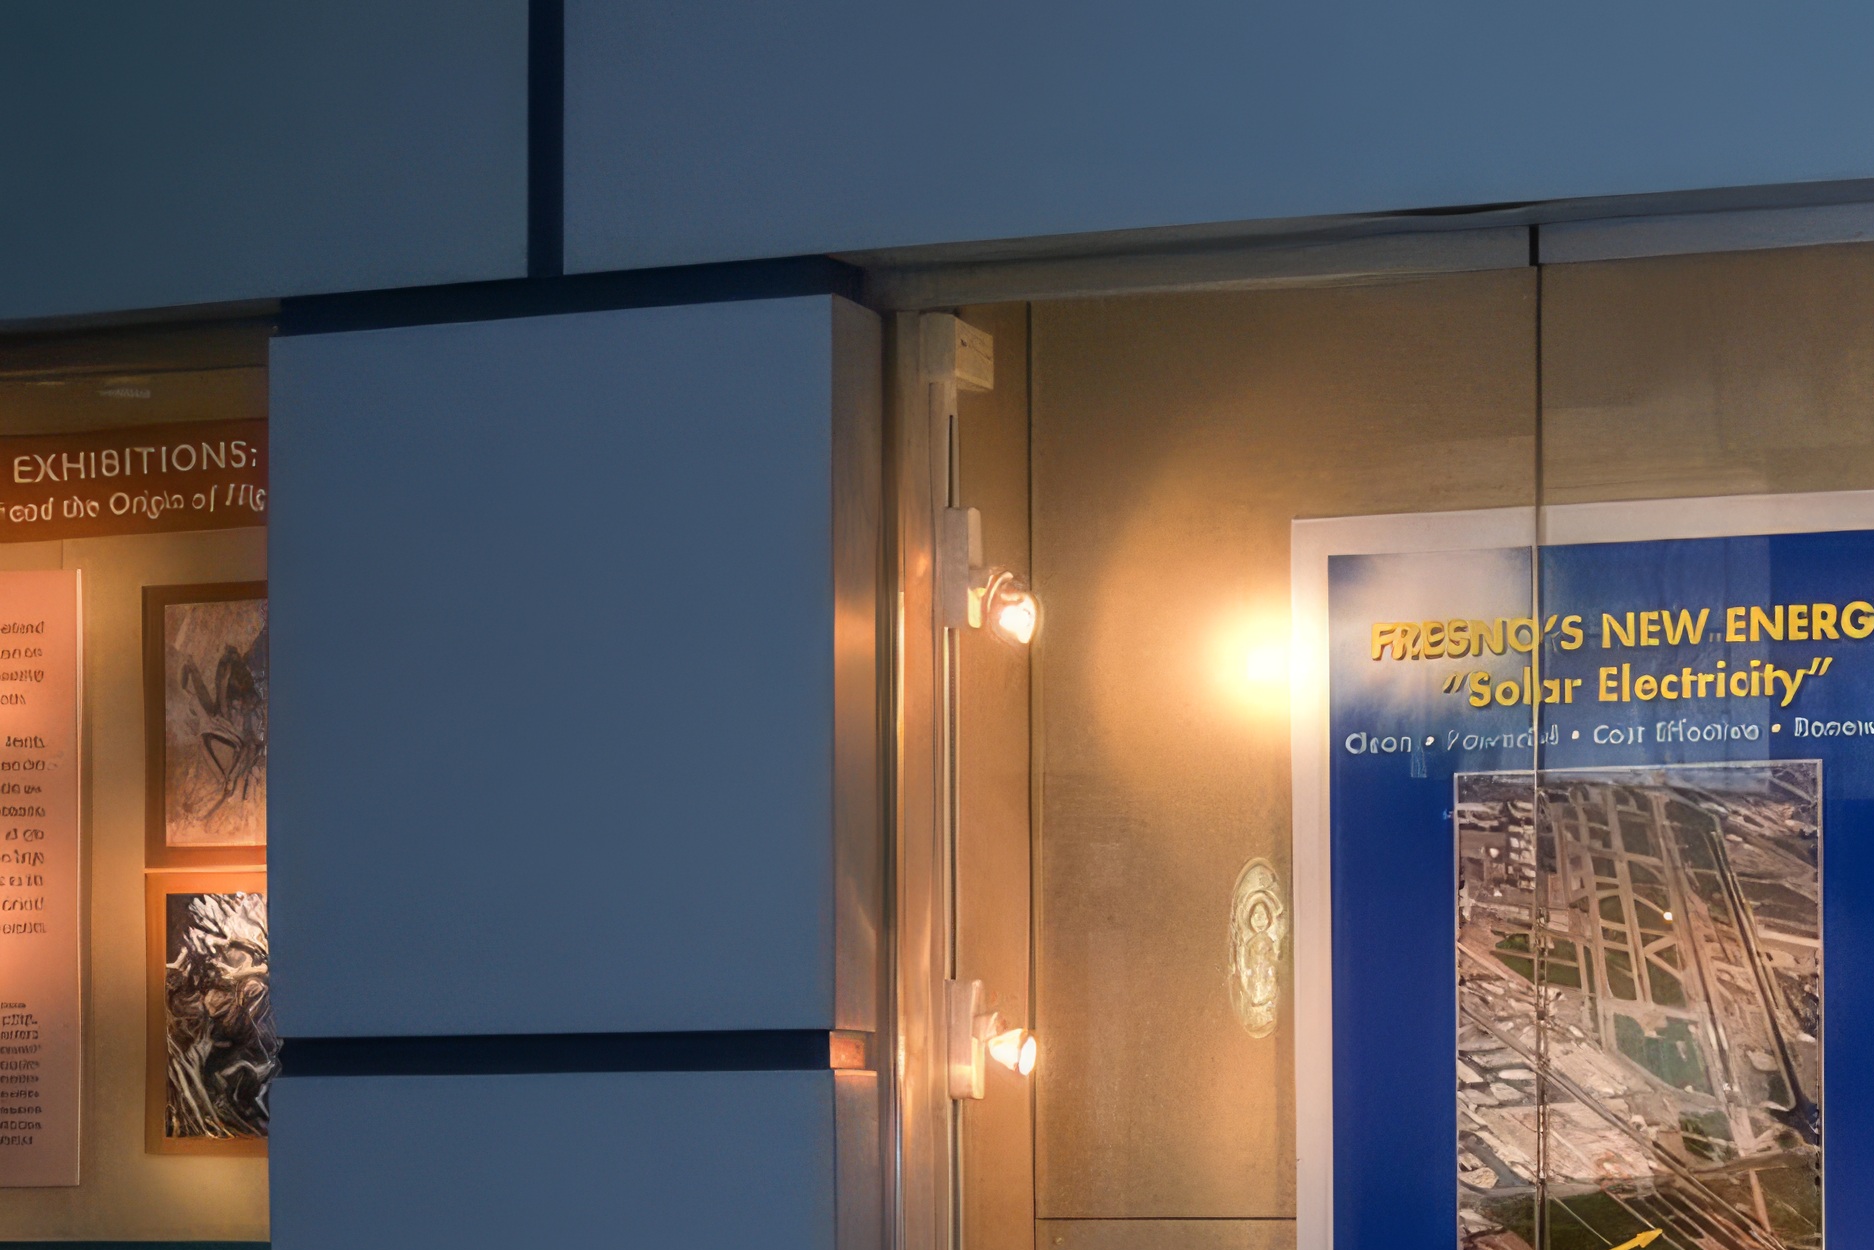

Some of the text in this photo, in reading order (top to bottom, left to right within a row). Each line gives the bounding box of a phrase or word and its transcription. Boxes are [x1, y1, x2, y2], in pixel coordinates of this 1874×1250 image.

[14, 440, 257, 483] EXHIBITIONS:
[192, 484, 217, 512] of
[1371, 613, 1583, 661] FRESNO'S
[1602, 608, 1710, 648] NEW
[1442, 656, 1833, 707] "Solar Electricity"
